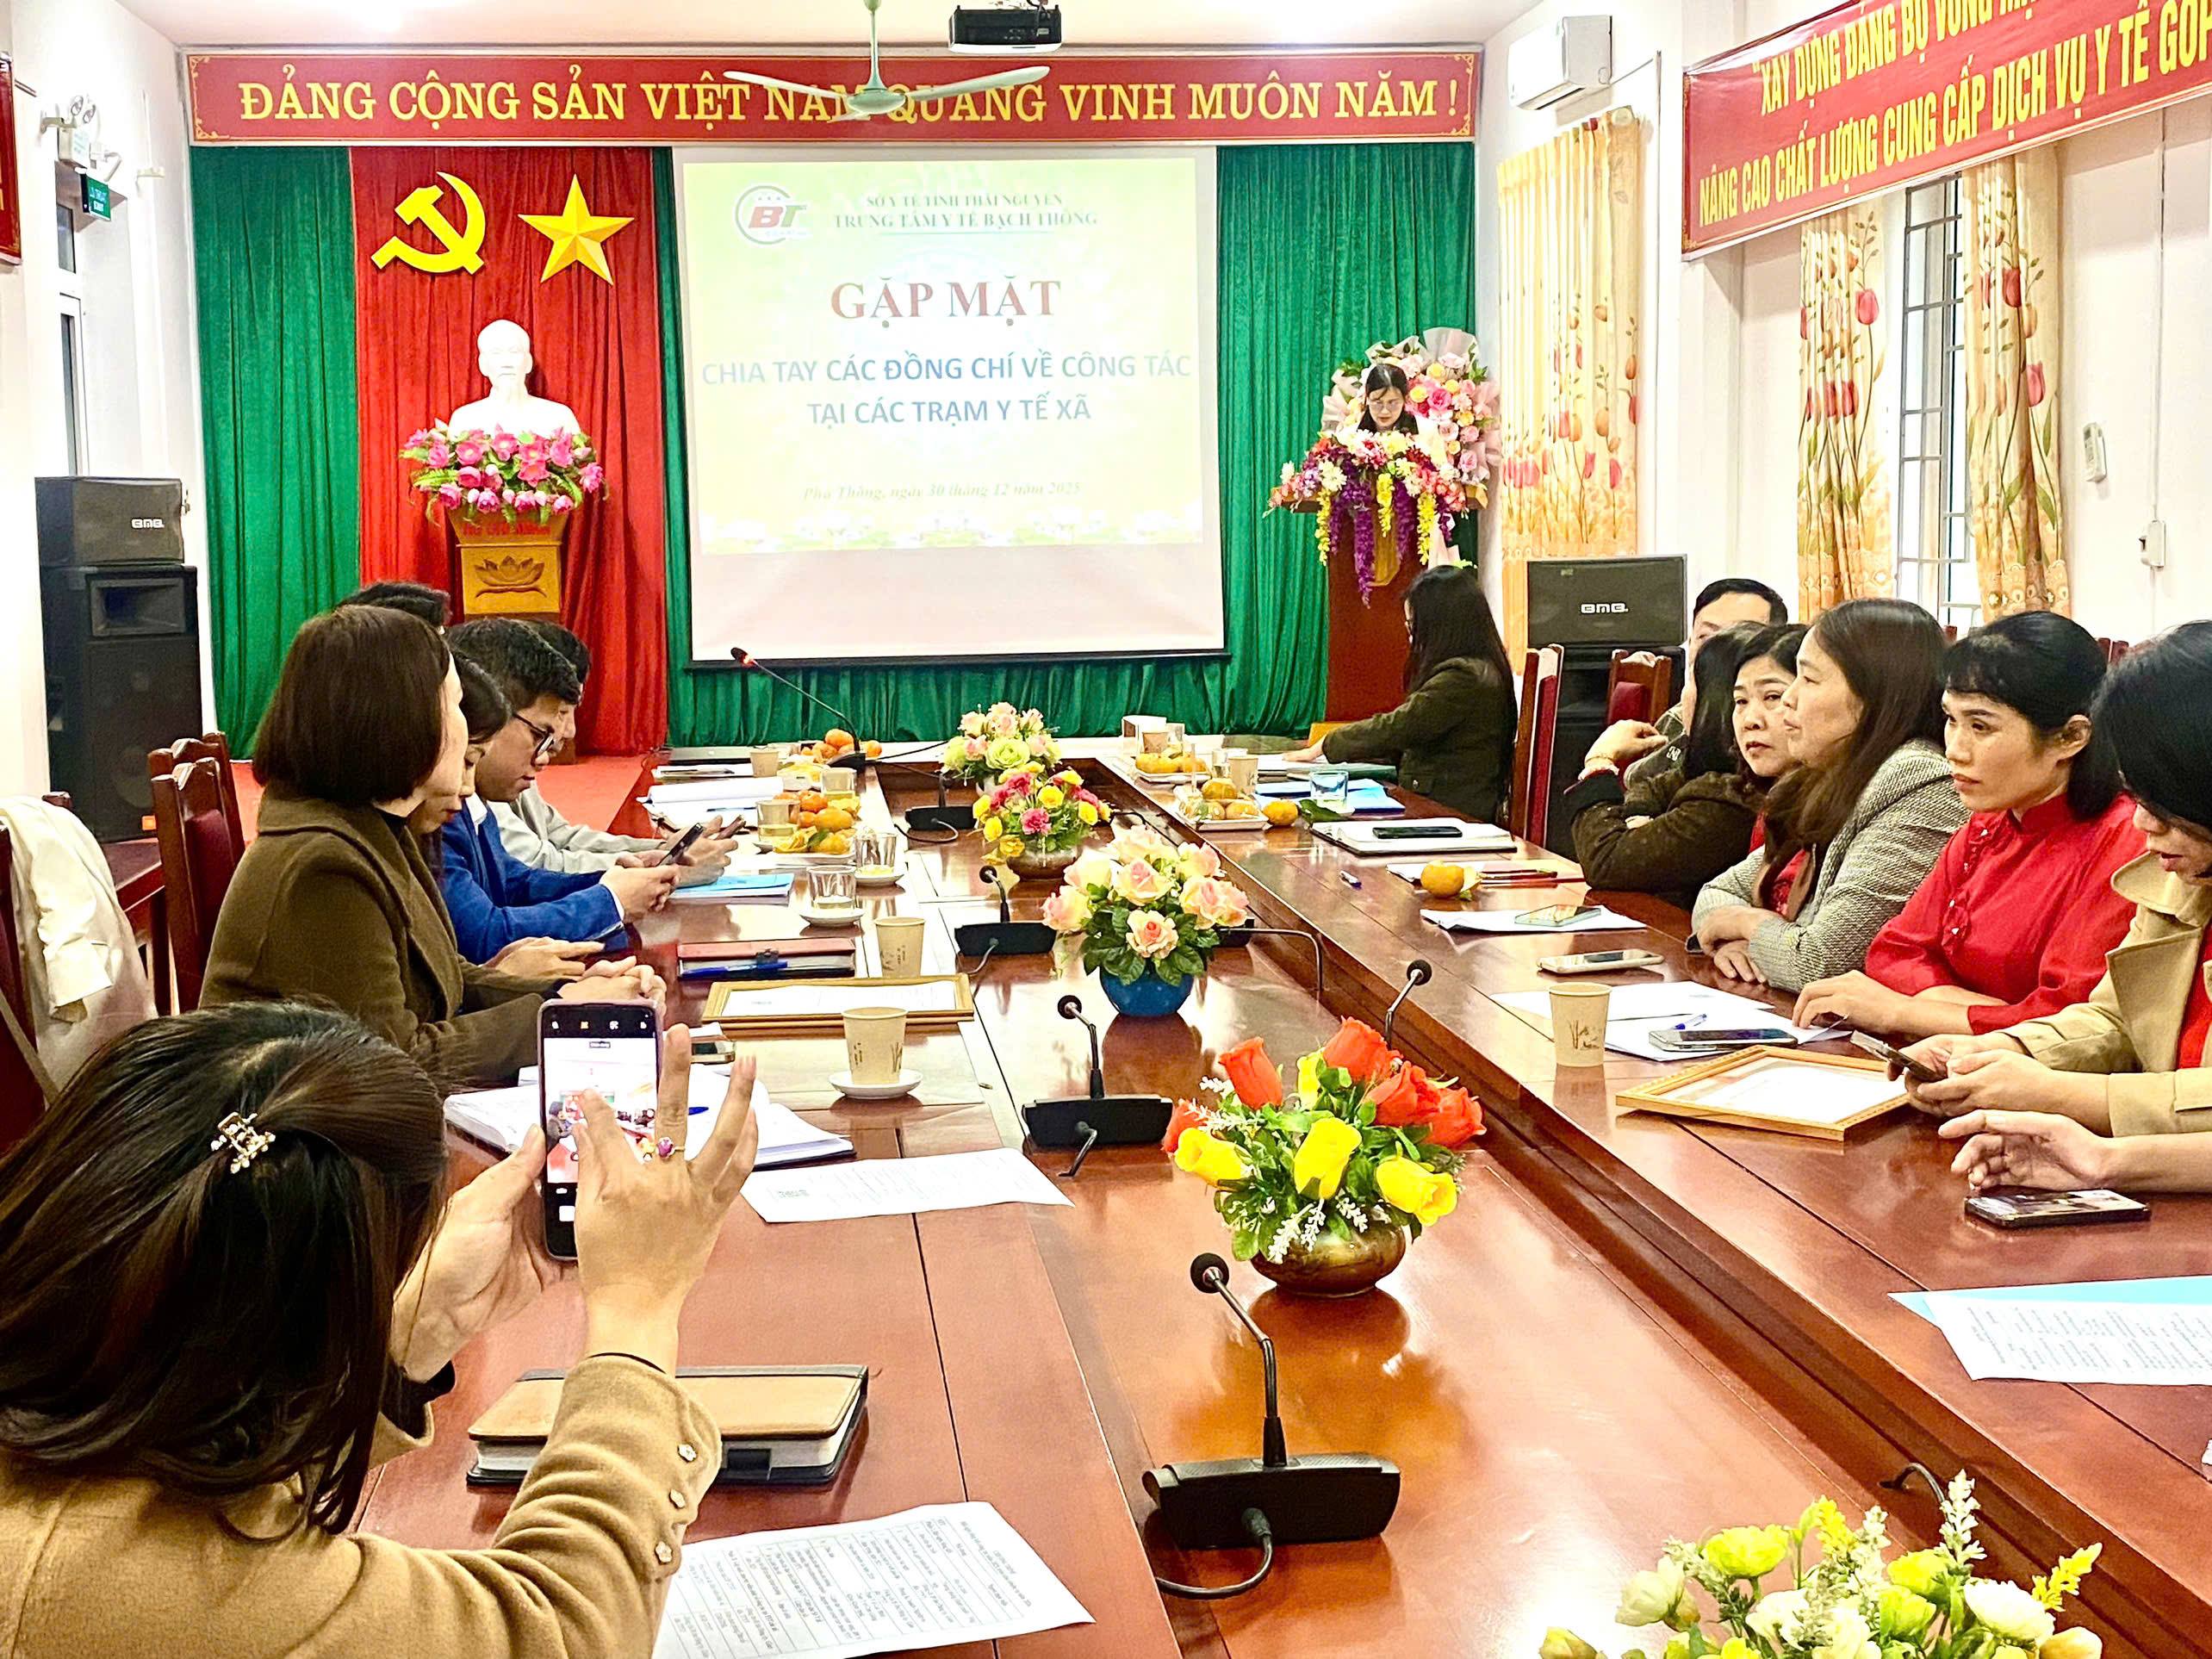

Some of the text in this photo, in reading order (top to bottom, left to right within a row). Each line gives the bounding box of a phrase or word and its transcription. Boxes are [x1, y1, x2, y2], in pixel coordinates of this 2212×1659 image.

[1845, 2, 1896, 79] ĐẢNG
[240, 64, 376, 120] ĐẢNG
[389, 69, 519, 130] CỘNG
[533, 64, 626, 120] SẢN
[641, 71, 749, 130] VIỆT
[886, 84, 1047, 124] QUANG
[1059, 84, 1175, 121] VINH
[1189, 70, 1322, 120] MUÔN
[1336, 70, 1438, 117] NĂM
[1699, 164, 1737, 227] NÂNG
[1742, 155, 1771, 213] CAO
[1775, 120, 1816, 202] CHẤT
[1820, 114, 1878, 193] LƯỢNG
[1883, 92, 1936, 166] CUNG
[1942, 54, 1985, 147] CẤP
[1992, 48, 2047, 141] DỊCH
[2054, 34, 2087, 119] VỤ
[2095, 24, 2111, 96] Y
[830, 276, 1061, 328] GẶP MẶT
[702, 348, 1190, 385] CHIA TAY CÁC ĐỒNG CHÍ VỀ CÔNG TÁC
[807, 390, 1090, 430] TẠI CÁC TRẠM Y TẾ XÃ
